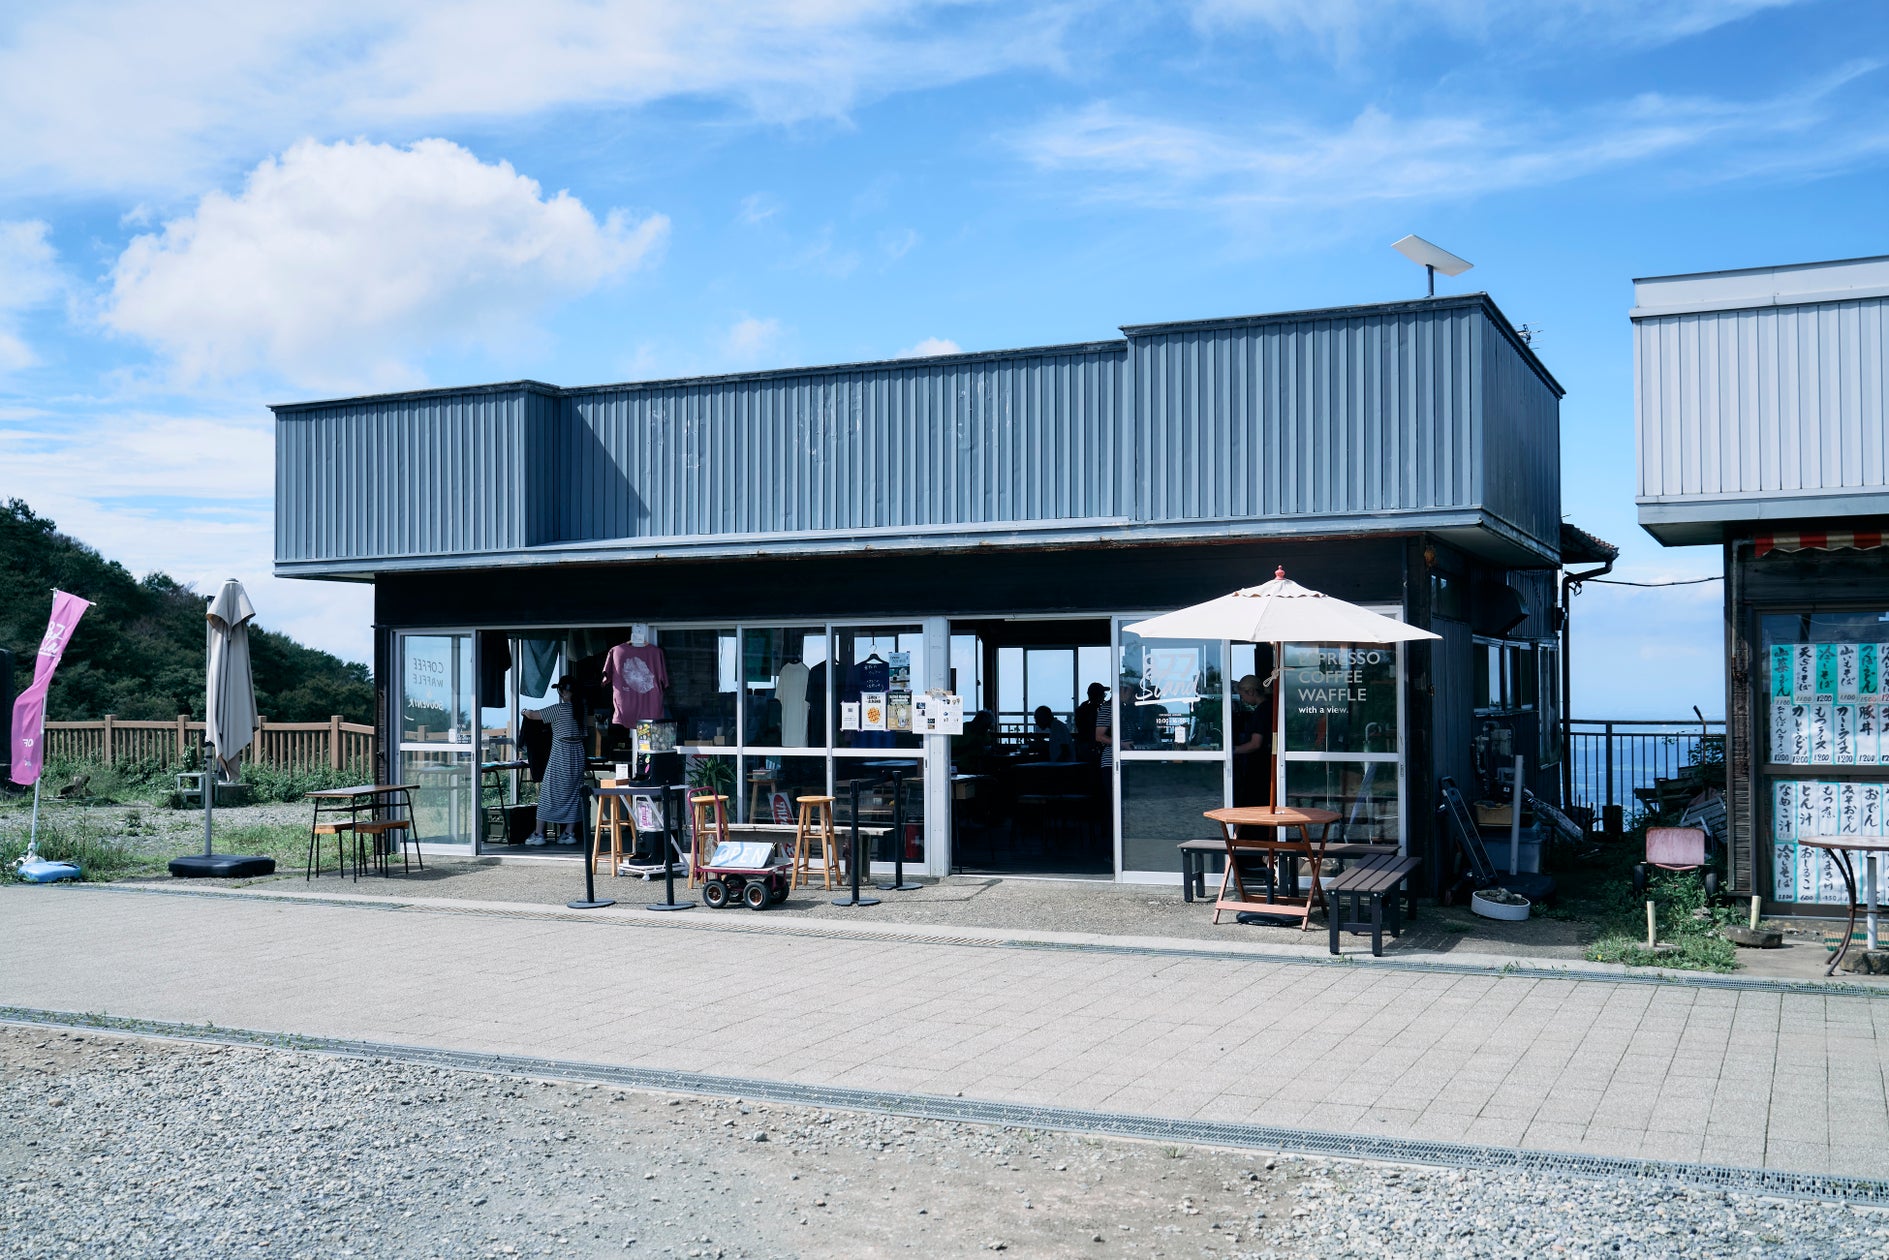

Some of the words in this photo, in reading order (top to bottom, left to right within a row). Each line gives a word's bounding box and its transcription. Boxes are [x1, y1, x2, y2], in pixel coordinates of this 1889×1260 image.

[1298, 651, 1381, 665] PRESSO
[1298, 669, 1363, 684] COFFEE
[1298, 688, 1367, 702] WAFFLE
[1816, 694, 1833, 702] 1200
[1298, 705, 1318, 714] with
[1327, 705, 1349, 714] view.
[1779, 784, 1792, 833] なめこ汁
[1800, 785, 1814, 826] とん汁
[1864, 787, 1879, 828] おでん
[717, 847, 767, 864] OPEN
[1800, 847, 1815, 890] おしるこ
